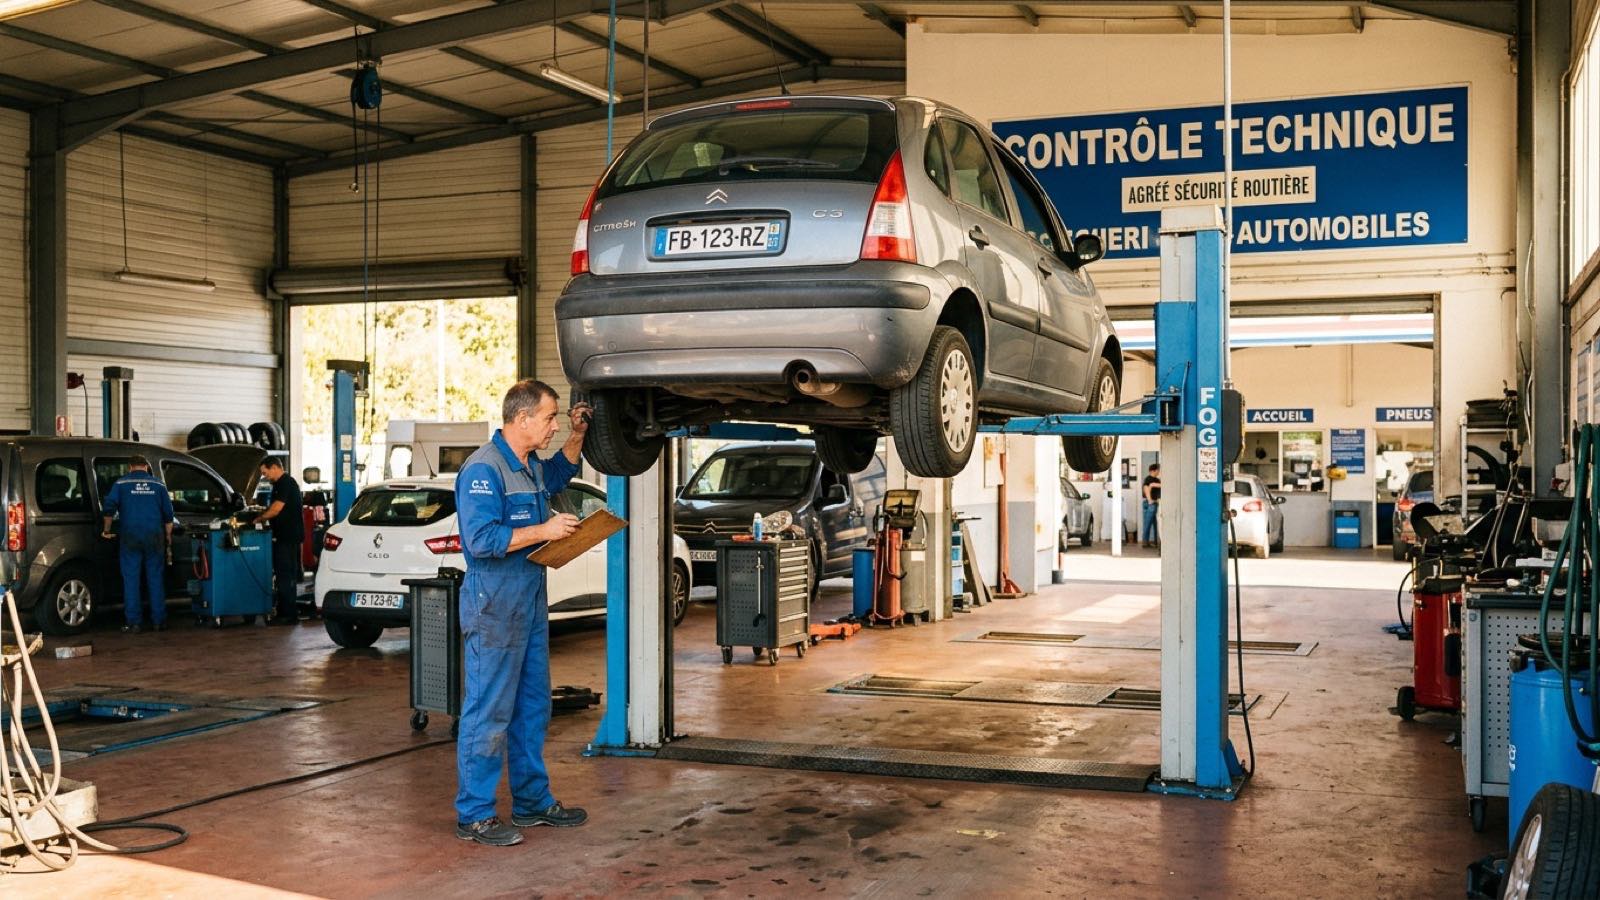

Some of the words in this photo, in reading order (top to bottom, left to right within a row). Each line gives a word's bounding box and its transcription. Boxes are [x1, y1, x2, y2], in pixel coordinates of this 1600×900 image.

[1005, 117, 1203, 169] CONTRÔLE
[1215, 103, 1455, 155] TECHNIQUE
[1128, 181, 1169, 204] AGRÉÉ
[1243, 174, 1310, 198] ROUTIÈRE
[812, 209, 843, 218] C3
[668, 226, 766, 251] FB-123-RZ
[1199, 387, 1218, 446] FOG
[1252, 410, 1307, 421] ACCUEIL
[1386, 408, 1433, 420] PNEUS
